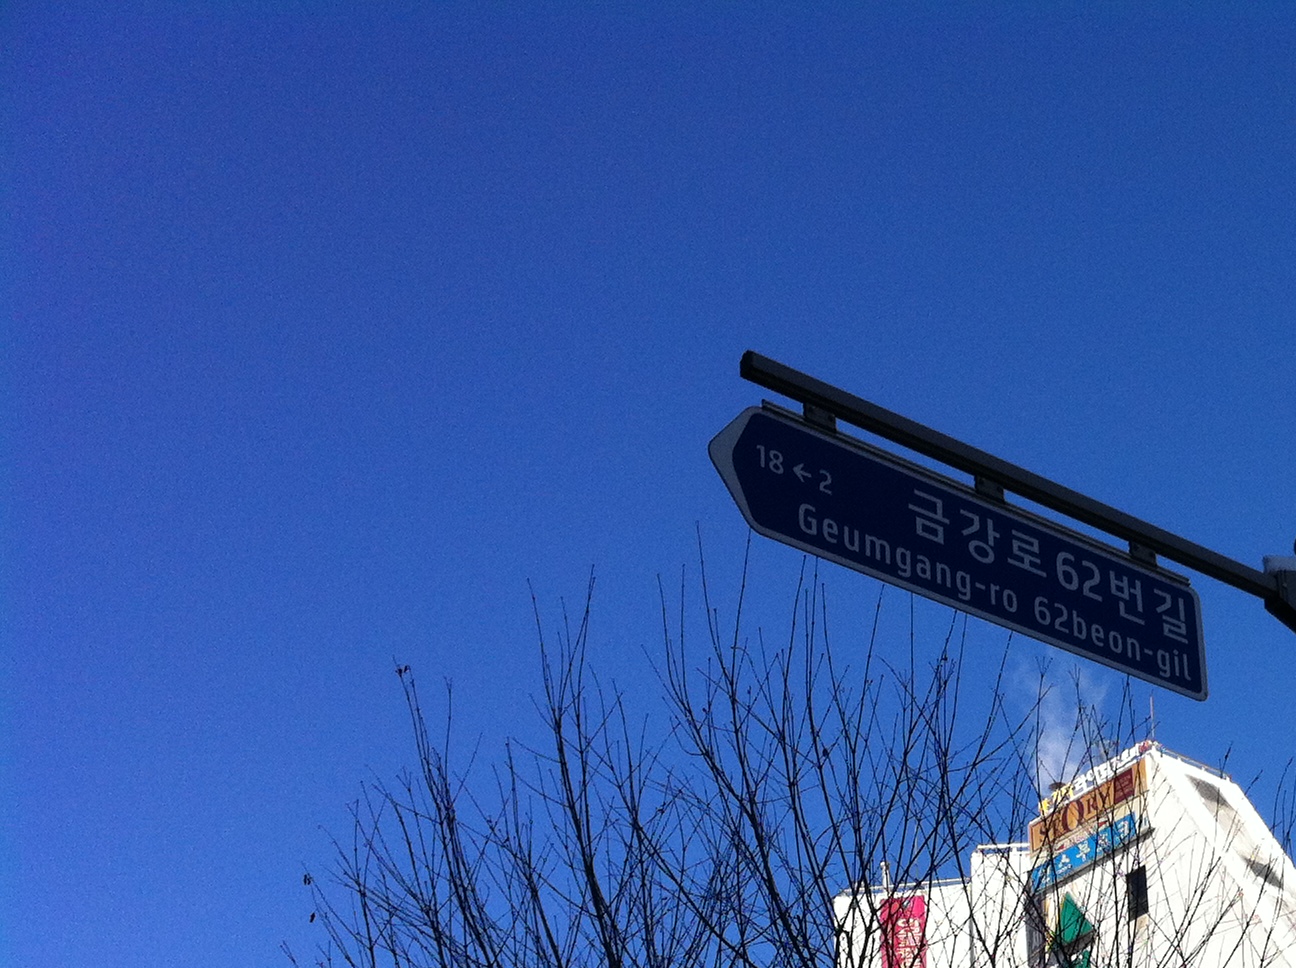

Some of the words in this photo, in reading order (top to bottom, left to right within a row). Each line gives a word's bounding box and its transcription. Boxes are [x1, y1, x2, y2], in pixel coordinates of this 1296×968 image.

[756, 445, 784, 474] 18
[819, 470, 832, 495] 2
[799, 504, 1018, 613] Geumgang-ro
[1033, 597, 1191, 682] 62beon-gil
[908, 488, 1189, 645] 금강로62번길
